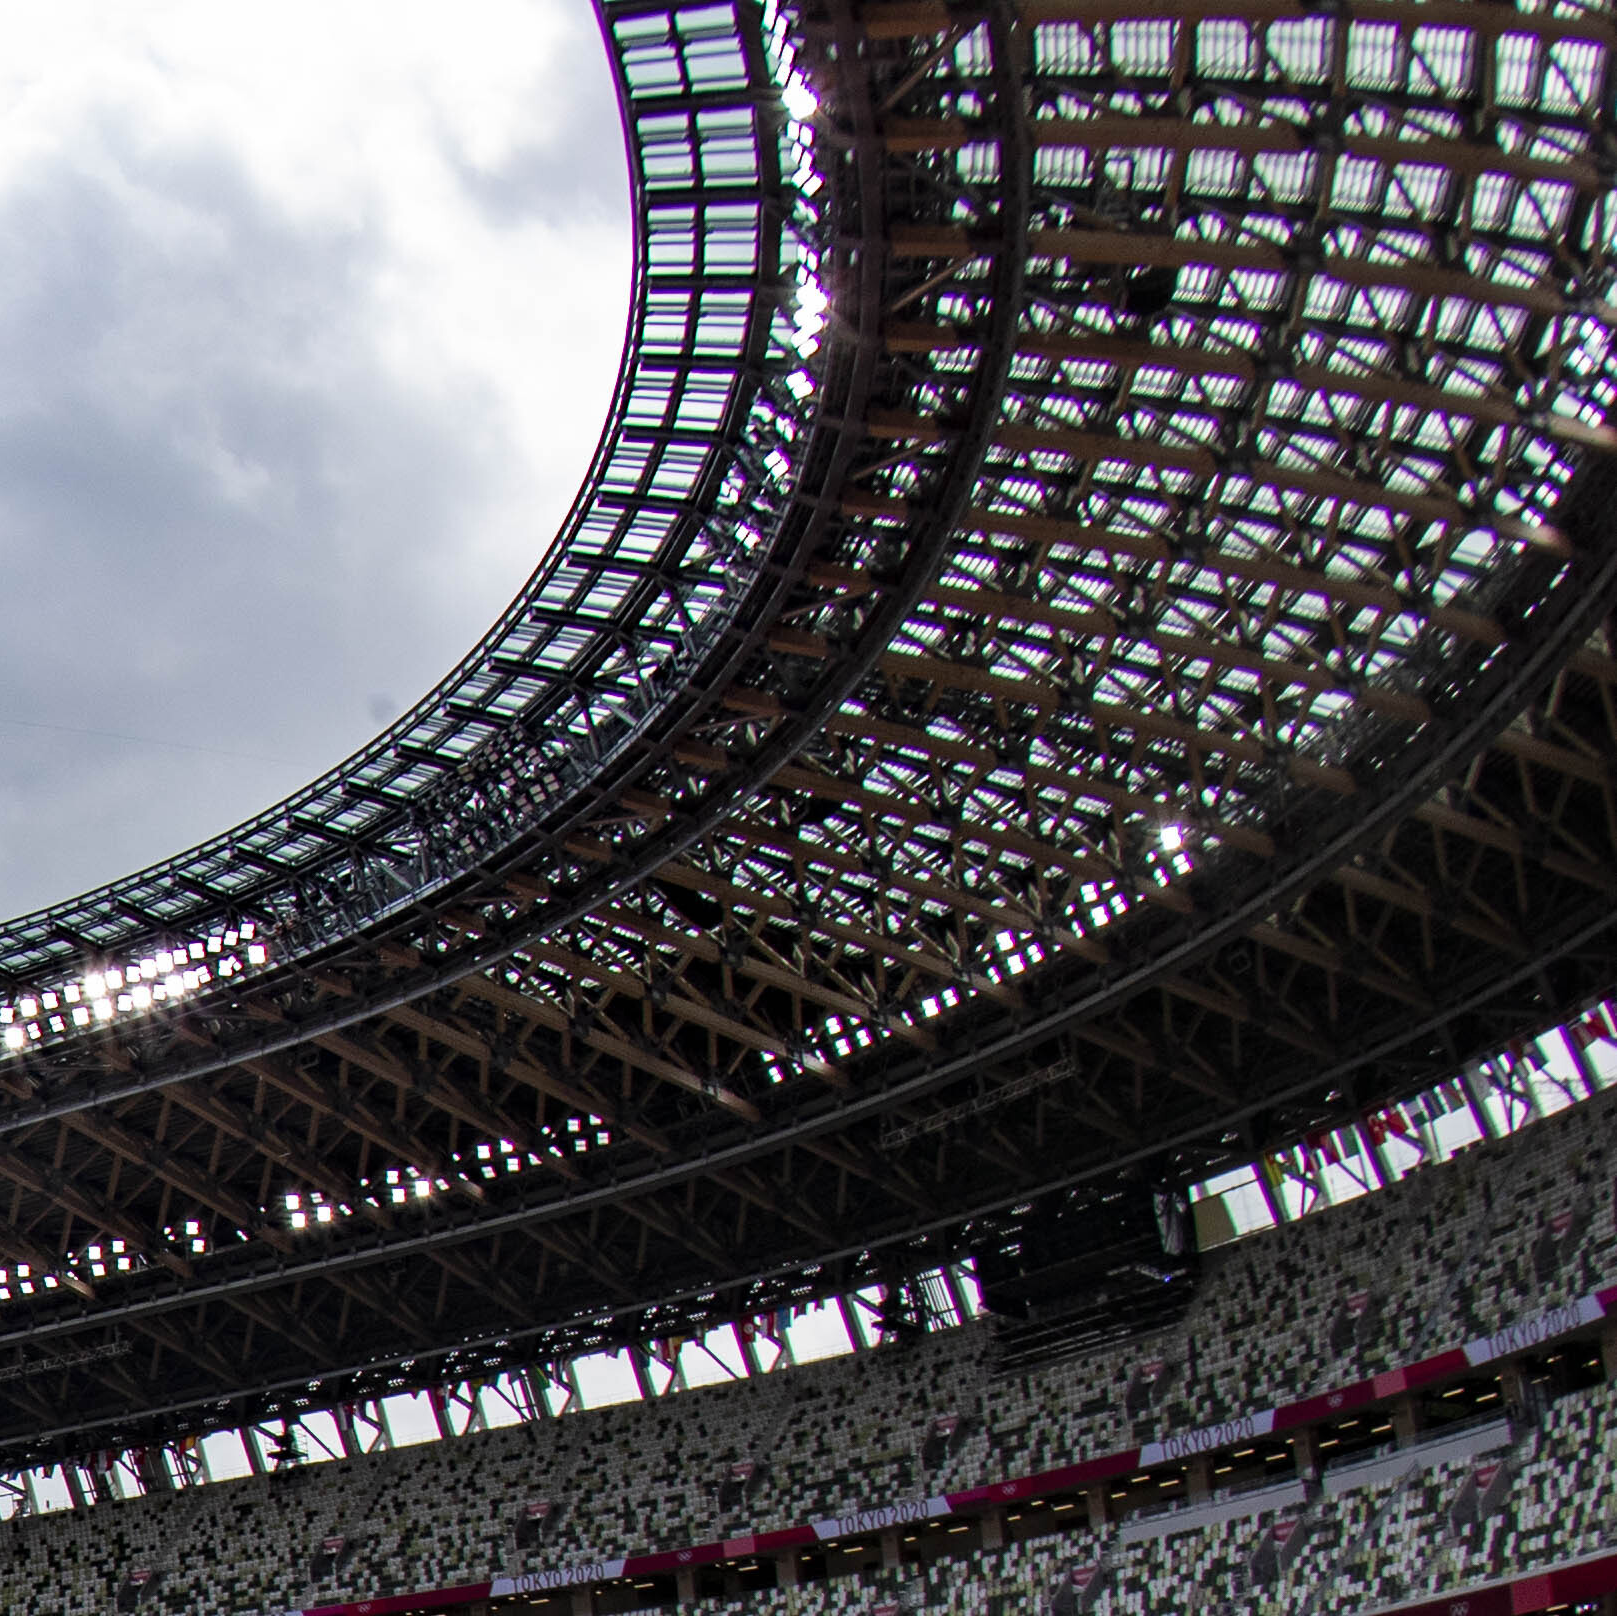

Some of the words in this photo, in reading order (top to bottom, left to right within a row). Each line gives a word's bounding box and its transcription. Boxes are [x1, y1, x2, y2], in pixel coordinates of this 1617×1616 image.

[1488, 1319, 1538, 1359] TOKYO
[1543, 1303, 1581, 1339] 2020
[1161, 1426, 1211, 1459] TOKYO
[1214, 1417, 1254, 1448] 2020
[838, 1510, 887, 1537] TOKYO
[891, 1501, 928, 1524] 2020
[511, 1569, 562, 1593] TOKYO
[566, 1563, 604, 1584] 2020
